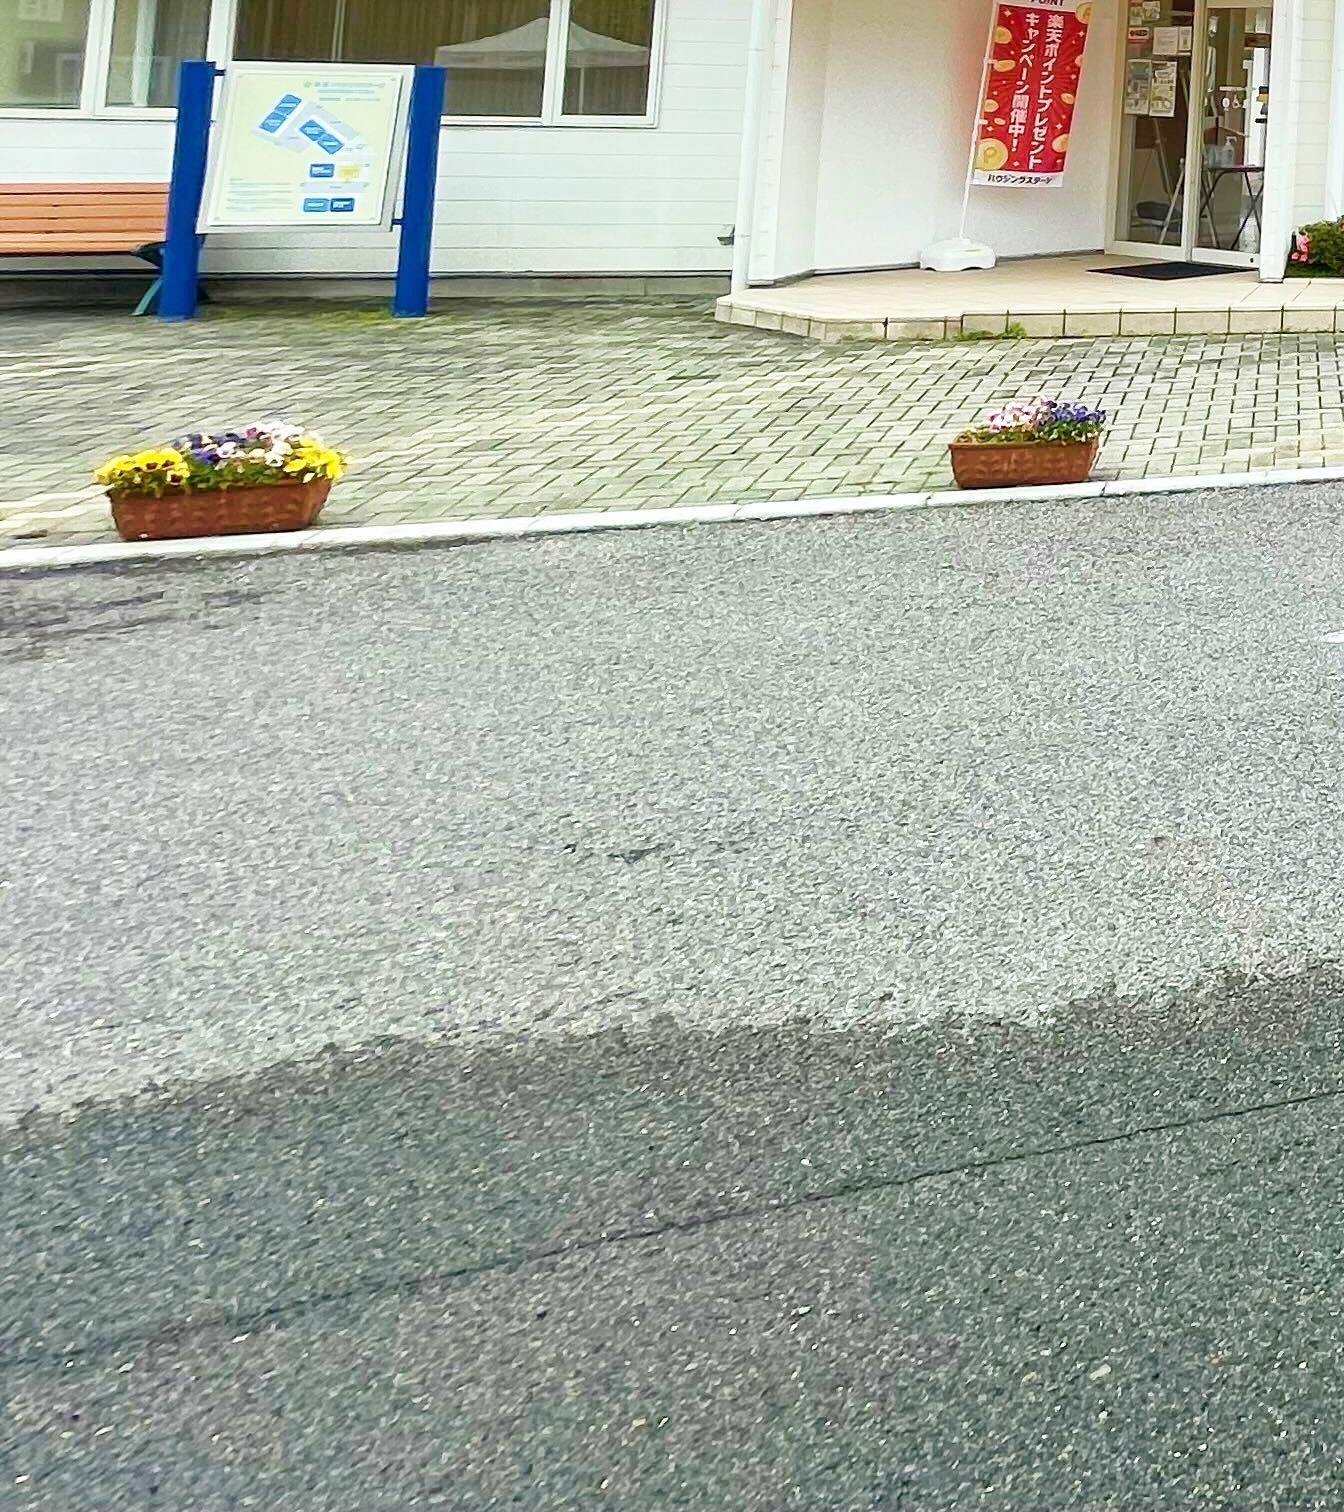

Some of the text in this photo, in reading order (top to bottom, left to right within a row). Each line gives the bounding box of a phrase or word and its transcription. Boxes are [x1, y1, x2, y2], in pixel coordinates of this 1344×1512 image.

[1028, 14, 1065, 170] 楽天ポイントプレゼント
